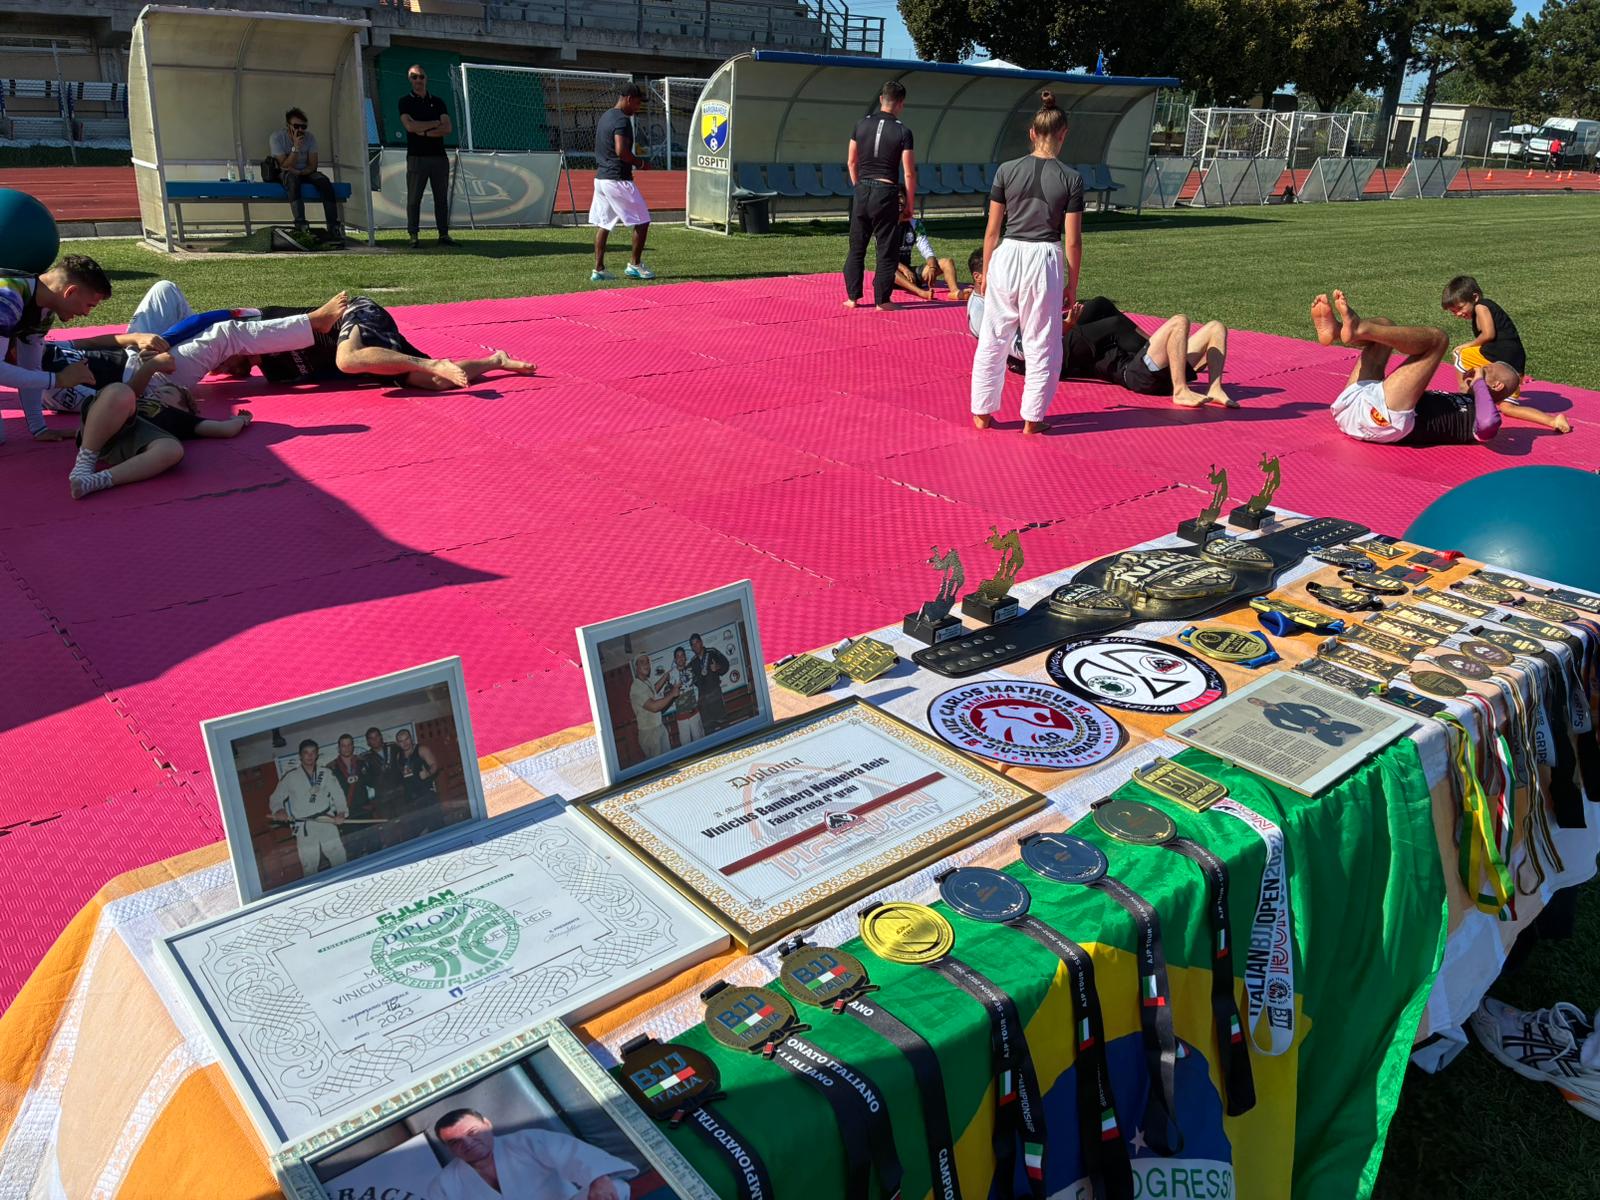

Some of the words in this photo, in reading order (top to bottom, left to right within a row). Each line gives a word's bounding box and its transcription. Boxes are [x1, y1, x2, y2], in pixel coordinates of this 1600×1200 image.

[698, 156, 727, 168] OSPITI
[939, 687, 985, 717] CARLOS
[986, 684, 1078, 710] MATHEUS
[944, 716, 972, 742] LUIZ
[1038, 731, 1061, 744] 40
[983, 742, 1070, 759] JIU-JITSU
[725, 756, 804, 790] Diploma
[701, 811, 760, 840] Vinicius
[754, 786, 815, 818] Bamberg
[808, 766, 865, 795] Nogueira
[862, 755, 891, 773] Reis
[767, 810, 799, 827] Faixa
[795, 799, 824, 818] Preta
[831, 783, 860, 803] grau
[381, 901, 478, 947] DIPLOMA
[332, 976, 395, 1006] VINICIUS
[392, 949, 461, 981] BAMBERG
[460, 921, 524, 956] NOGUEIRA
[522, 908, 553, 928] REIS
[363, 946, 427, 980] MAESTRO
[429, 926, 485, 952] CINTURA
[370, 929, 443, 963] BRAZILIAN
[1056, 940, 1081, 966] SEASON
[793, 951, 840, 983] BJJ
[811, 973, 856, 997] ITALIA
[979, 984, 1004, 1012] SEASON
[378, 1006, 415, 1029] 2023
[717, 993, 766, 1027] BJJ
[739, 1012, 783, 1043] ITALIA
[1000, 1018, 1009, 1042] TOUR
[630, 1051, 688, 1092] BJJ
[785, 1037, 828, 1065] ONATO
[825, 1060, 880, 1114] ITALIANO
[650, 1076, 703, 1105] ITALIA
[938, 1148, 958, 1200] CAMPIO
